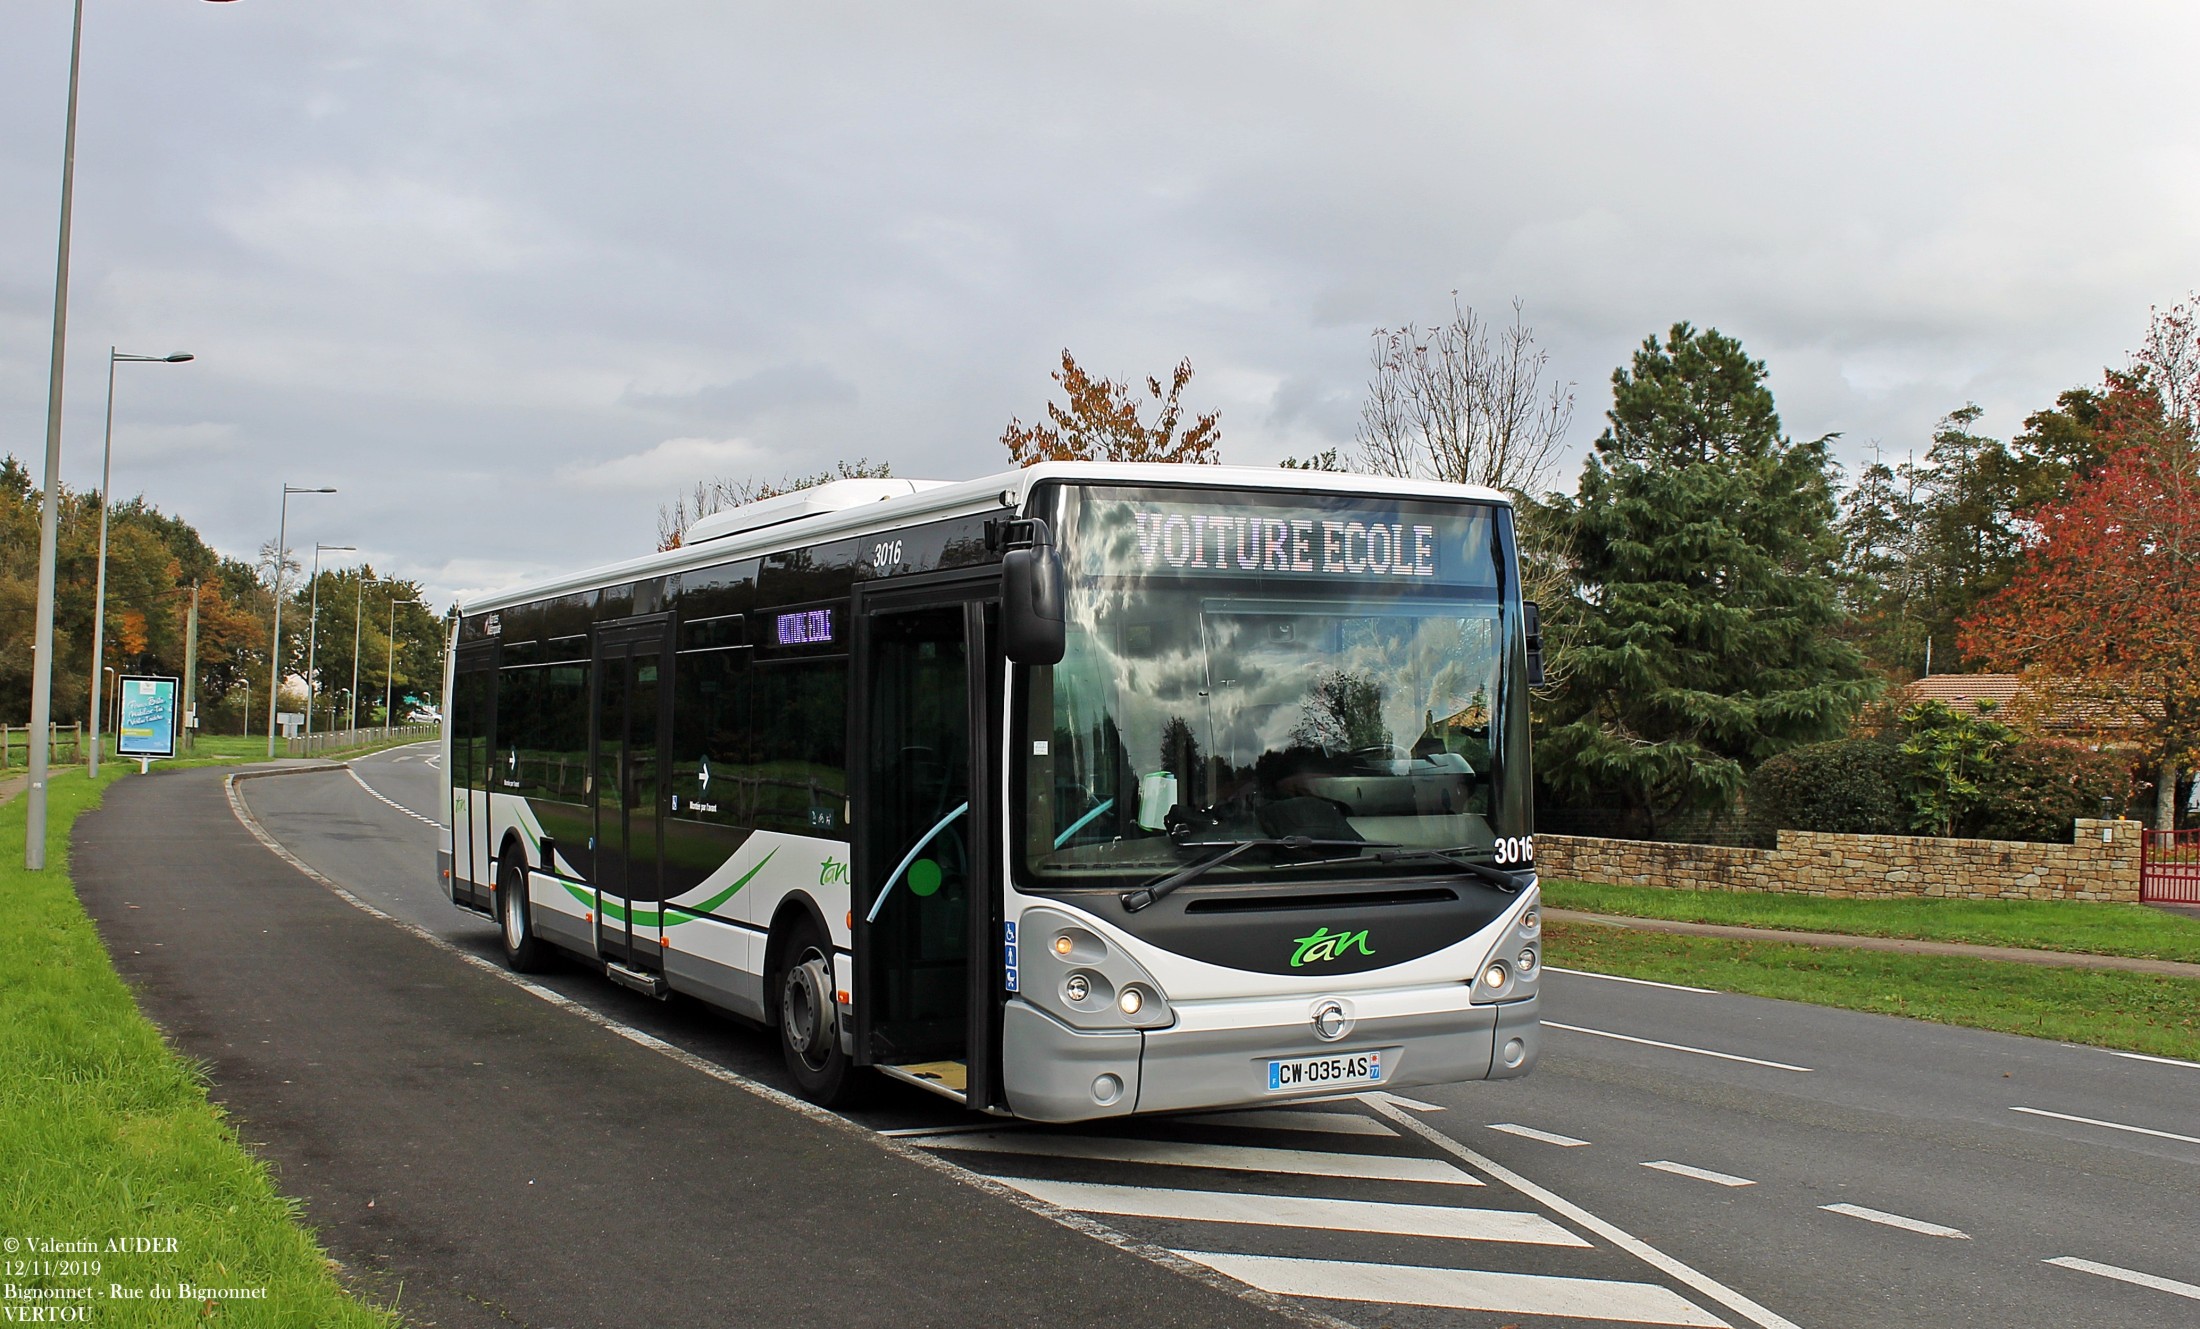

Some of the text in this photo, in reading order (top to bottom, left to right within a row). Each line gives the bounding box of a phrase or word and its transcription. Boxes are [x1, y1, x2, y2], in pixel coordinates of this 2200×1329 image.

[874, 540, 902, 568] 3016
[1135, 512, 1433, 575] VOITURE ECOLE
[1494, 835, 1533, 864] 3016
[820, 856, 849, 885] tan
[1290, 927, 1376, 967] tan
[1370, 1066, 1379, 1077] 77
